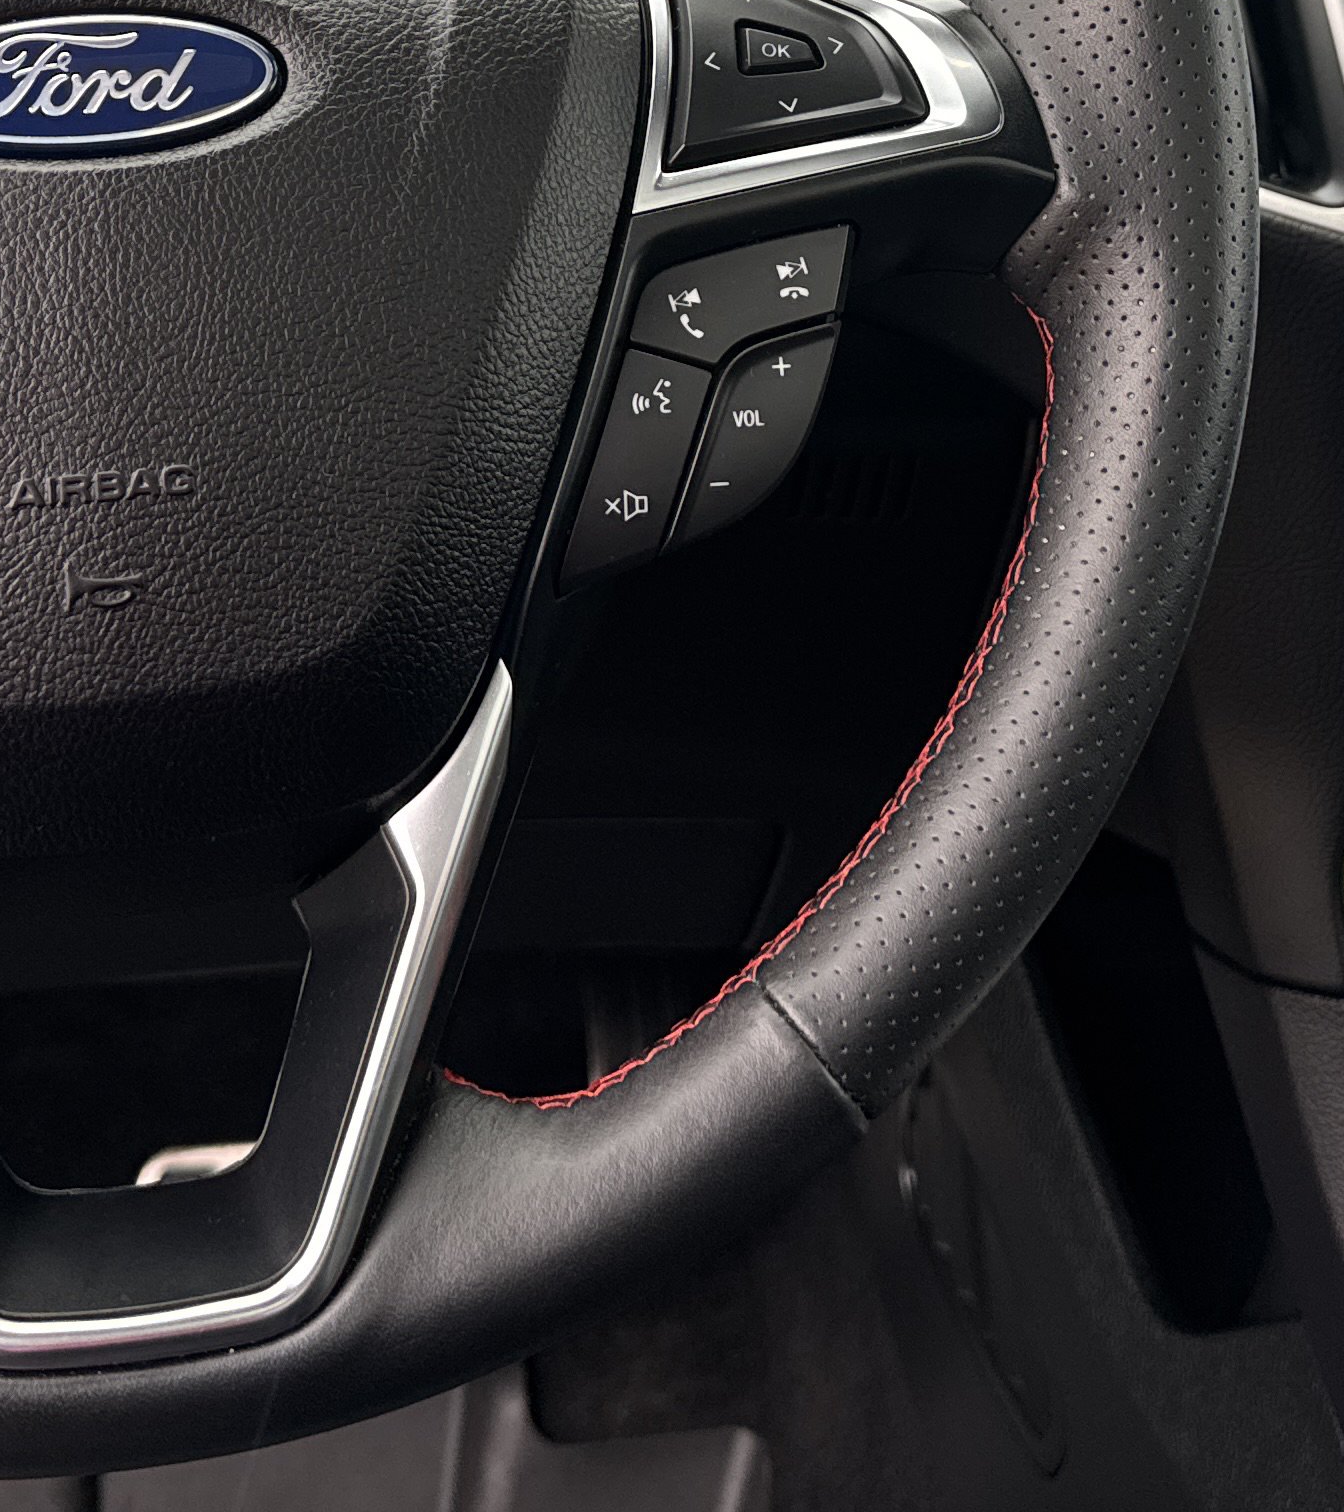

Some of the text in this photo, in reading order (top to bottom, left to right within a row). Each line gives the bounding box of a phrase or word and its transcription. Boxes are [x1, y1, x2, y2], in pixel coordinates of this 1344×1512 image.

[761, 43, 792, 59] OK
[733, 410, 765, 428] VOL
[6, 463, 197, 509] AIRBAG
